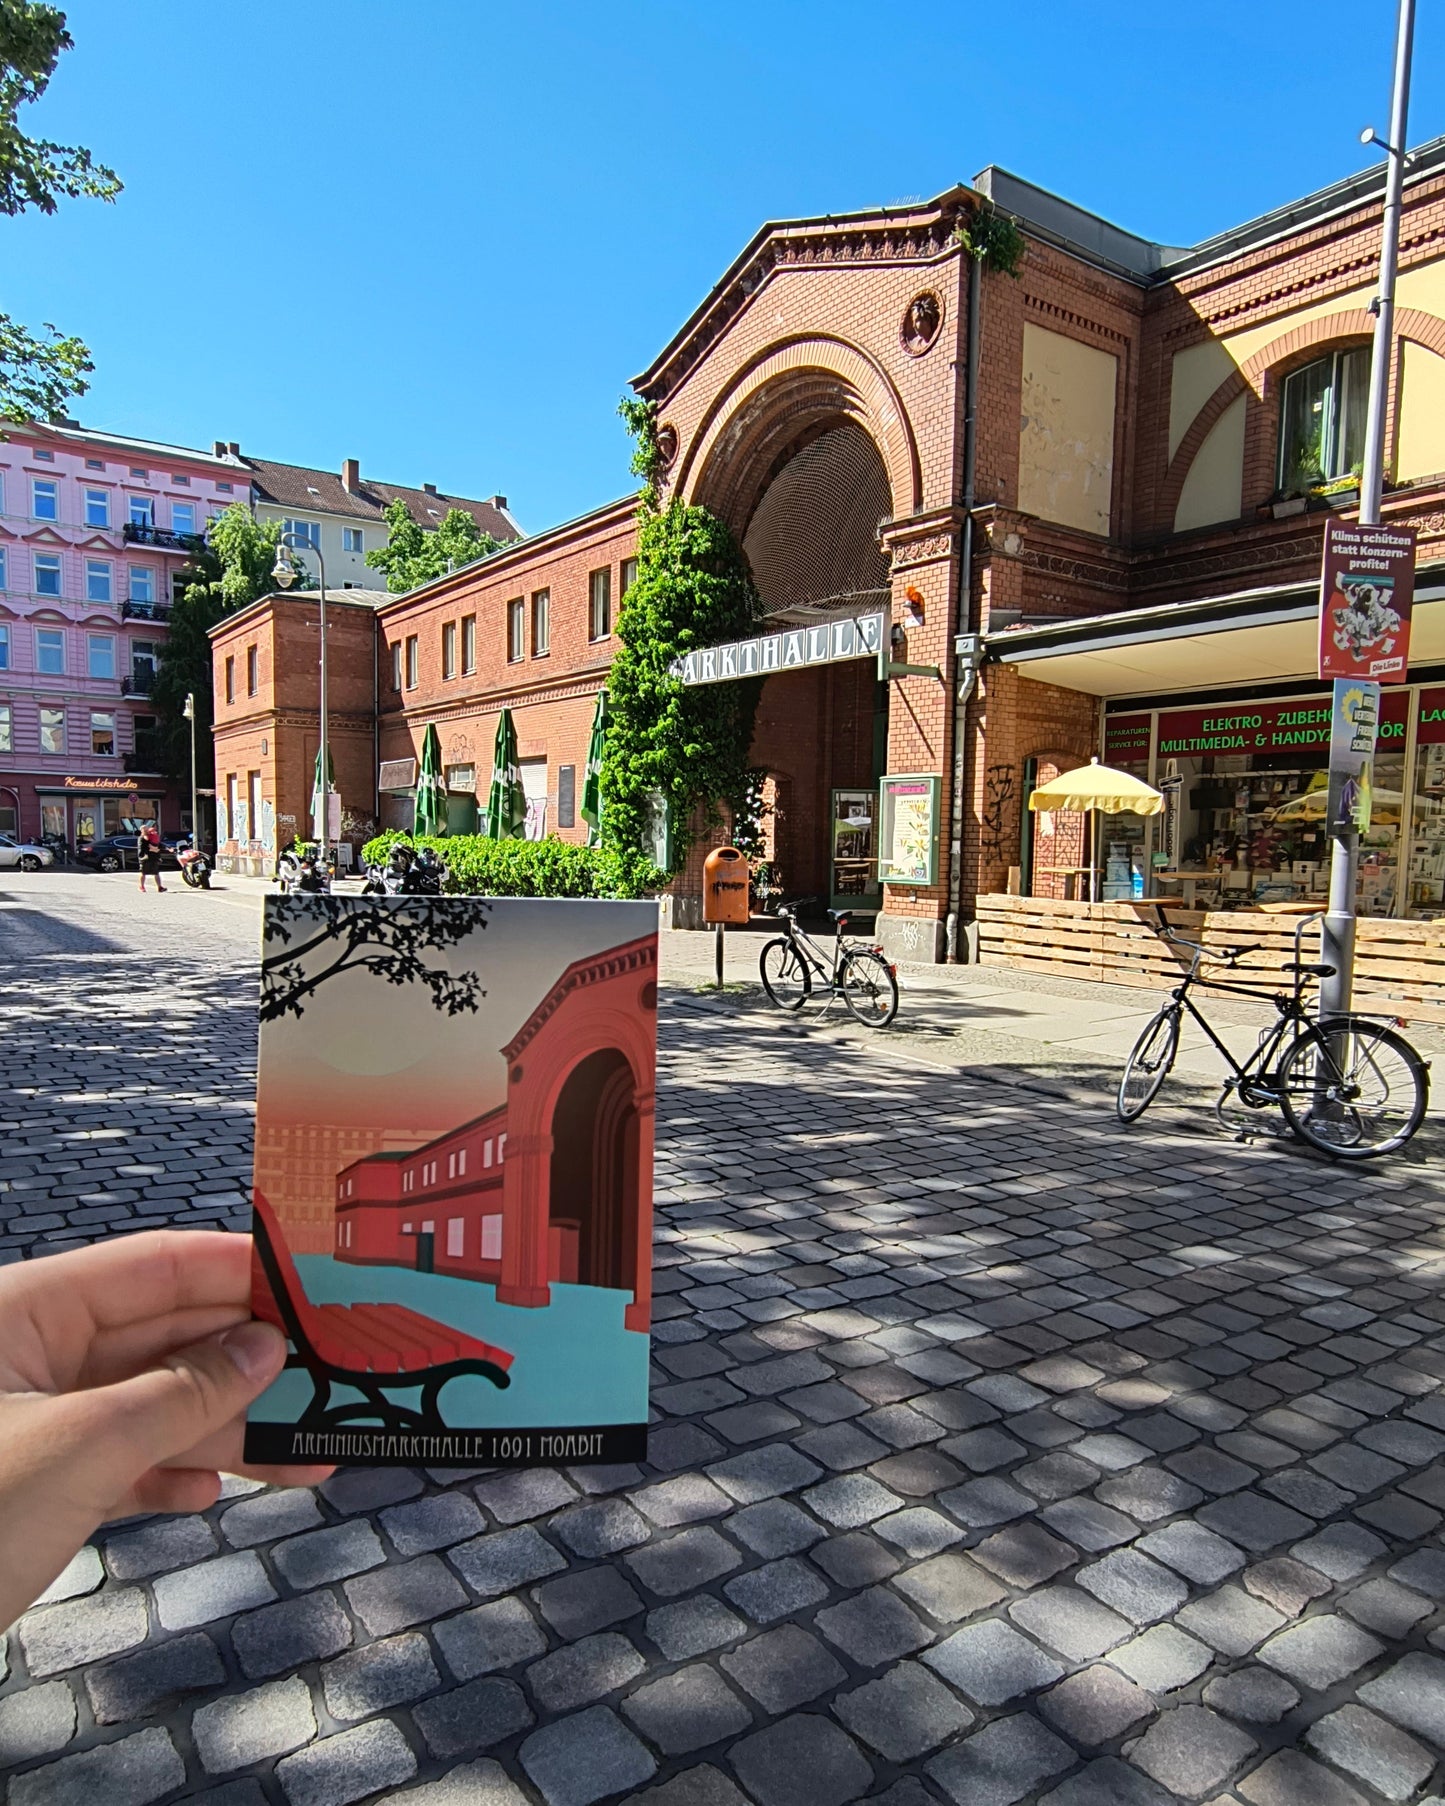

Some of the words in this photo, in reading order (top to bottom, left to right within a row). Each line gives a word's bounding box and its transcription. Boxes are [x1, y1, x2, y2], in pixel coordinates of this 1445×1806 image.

[1331, 530, 1360, 542] Klima
[1362, 533, 1412, 545] schützen
[1332, 544, 1358, 555] statt
[1360, 546, 1408, 558] Konzern-
[1349, 558, 1389, 570] profite!
[1373, 663, 1383, 671] Die
[1203, 715, 1262, 731] ELEKTRO
[1160, 735, 1250, 752] MULTIMEDIA-
[1255, 733, 1267, 746] &
[292, 1432, 483, 1458] ARMINIUSMARKTHALLE
[540, 1434, 604, 1457] MOABIT
